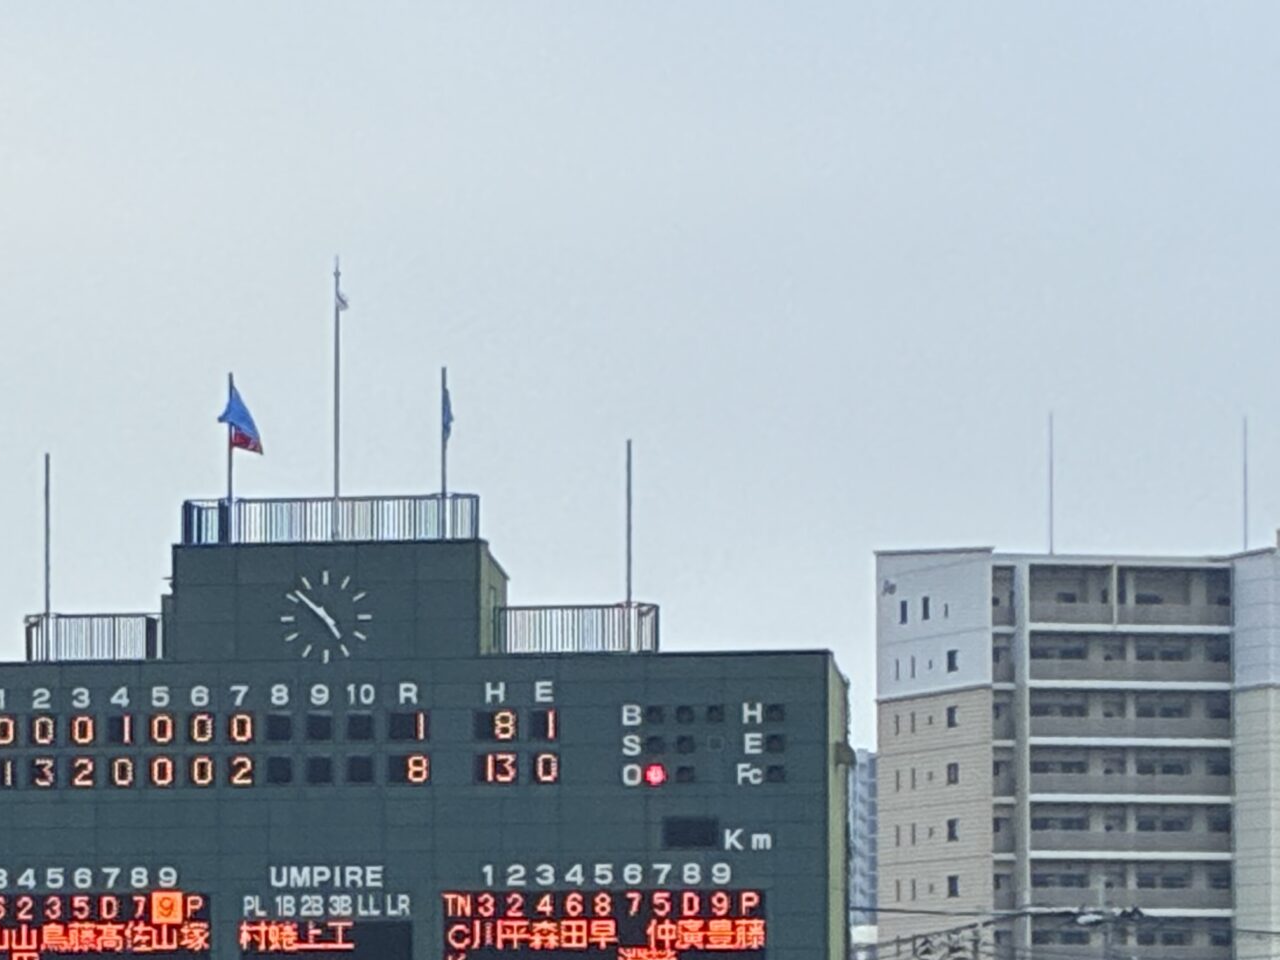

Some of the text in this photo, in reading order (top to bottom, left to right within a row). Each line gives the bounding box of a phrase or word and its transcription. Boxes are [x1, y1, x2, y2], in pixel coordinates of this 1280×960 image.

[33, 688, 51, 709] 2
[72, 687, 91, 708] 3
[110, 687, 130, 708] 4
[151, 686, 170, 707] 5
[190, 685, 209, 707] 6
[230, 685, 249, 706] 7
[271, 684, 289, 706] 8
[310, 684, 329, 706] 9
[346, 683, 376, 705] 10
[399, 683, 418, 705] R
[485, 682, 505, 703] H
[535, 681, 554, 703] E
[622, 704, 642, 726] B
[742, 702, 763, 724] H
[35, 717, 54, 745] 0
[73, 716, 93, 743] 0
[123, 715, 131, 744] 1
[152, 715, 173, 742] 0
[193, 714, 213, 742] 0
[232, 714, 252, 742] 0
[494, 711, 516, 740] 8
[547, 709, 556, 740] 1
[622, 734, 642, 756] S
[744, 732, 763, 754] E
[4, 759, 12, 786] 1
[35, 758, 54, 786] 3
[73, 758, 93, 786] 2
[113, 758, 133, 786] 0
[152, 757, 173, 785] 0
[193, 757, 213, 785] 0
[232, 756, 252, 785] 2
[407, 755, 429, 782] 8
[487, 753, 516, 782] 13
[536, 753, 558, 782] 0
[622, 764, 642, 785] O
[736, 762, 763, 785] Fc
[17, 868, 36, 890] 4
[46, 867, 64, 889] 5
[74, 867, 92, 889] 6
[101, 867, 121, 889] 7
[130, 867, 148, 888] 8
[158, 866, 177, 888] 9
[270, 865, 384, 888] UMPIRE
[482, 862, 732, 886] 1 2 3 4 5 6 7 8 9
[17, 896, 33, 920] 2
[45, 896, 61, 919] 3
[73, 896, 89, 919] 5
[133, 896, 147, 918] 7
[187, 895, 203, 918] P
[243, 895, 267, 916] PL
[275, 895, 296, 916] 1B
[300, 895, 324, 916] 2B
[328, 895, 352, 916] 3B
[386, 894, 411, 916] LR
[442, 893, 471, 917] TN
[477, 892, 495, 917] 3
[506, 892, 524, 917] 2
[536, 892, 553, 917] 4
[566, 892, 583, 917] 6
[594, 892, 612, 917] 8
[626, 892, 642, 916] 7
[653, 892, 670, 917] 5
[711, 892, 729, 916] 9
[741, 892, 759, 916] P
